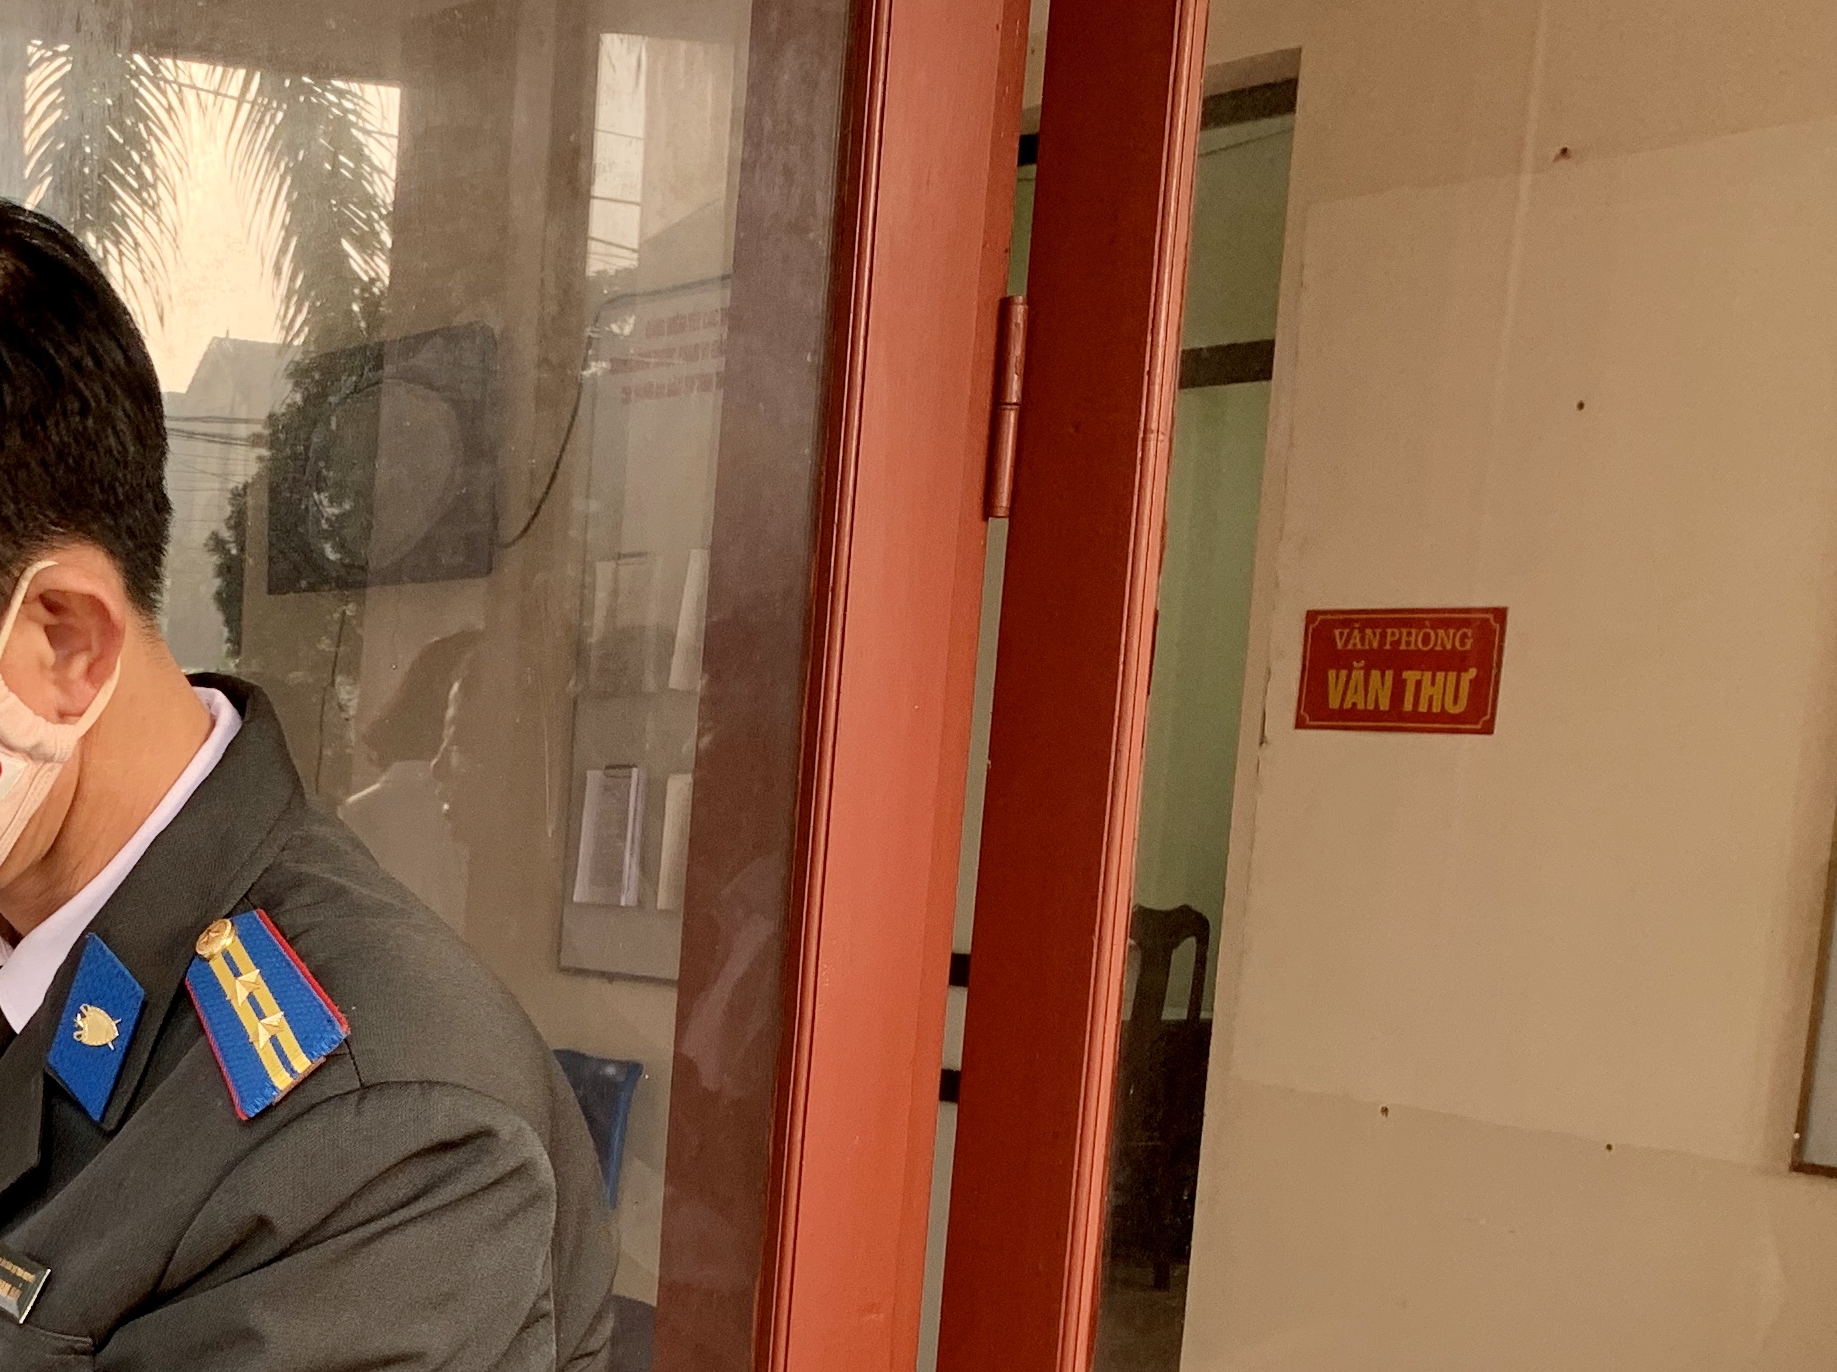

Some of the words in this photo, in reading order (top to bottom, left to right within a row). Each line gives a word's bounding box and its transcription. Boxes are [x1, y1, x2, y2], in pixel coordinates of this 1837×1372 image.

[1334, 622, 1382, 650] VĂN
[1385, 620, 1474, 651] PHÒNG
[1327, 659, 1394, 711] VĂN
[1402, 667, 1478, 714] THƯ
